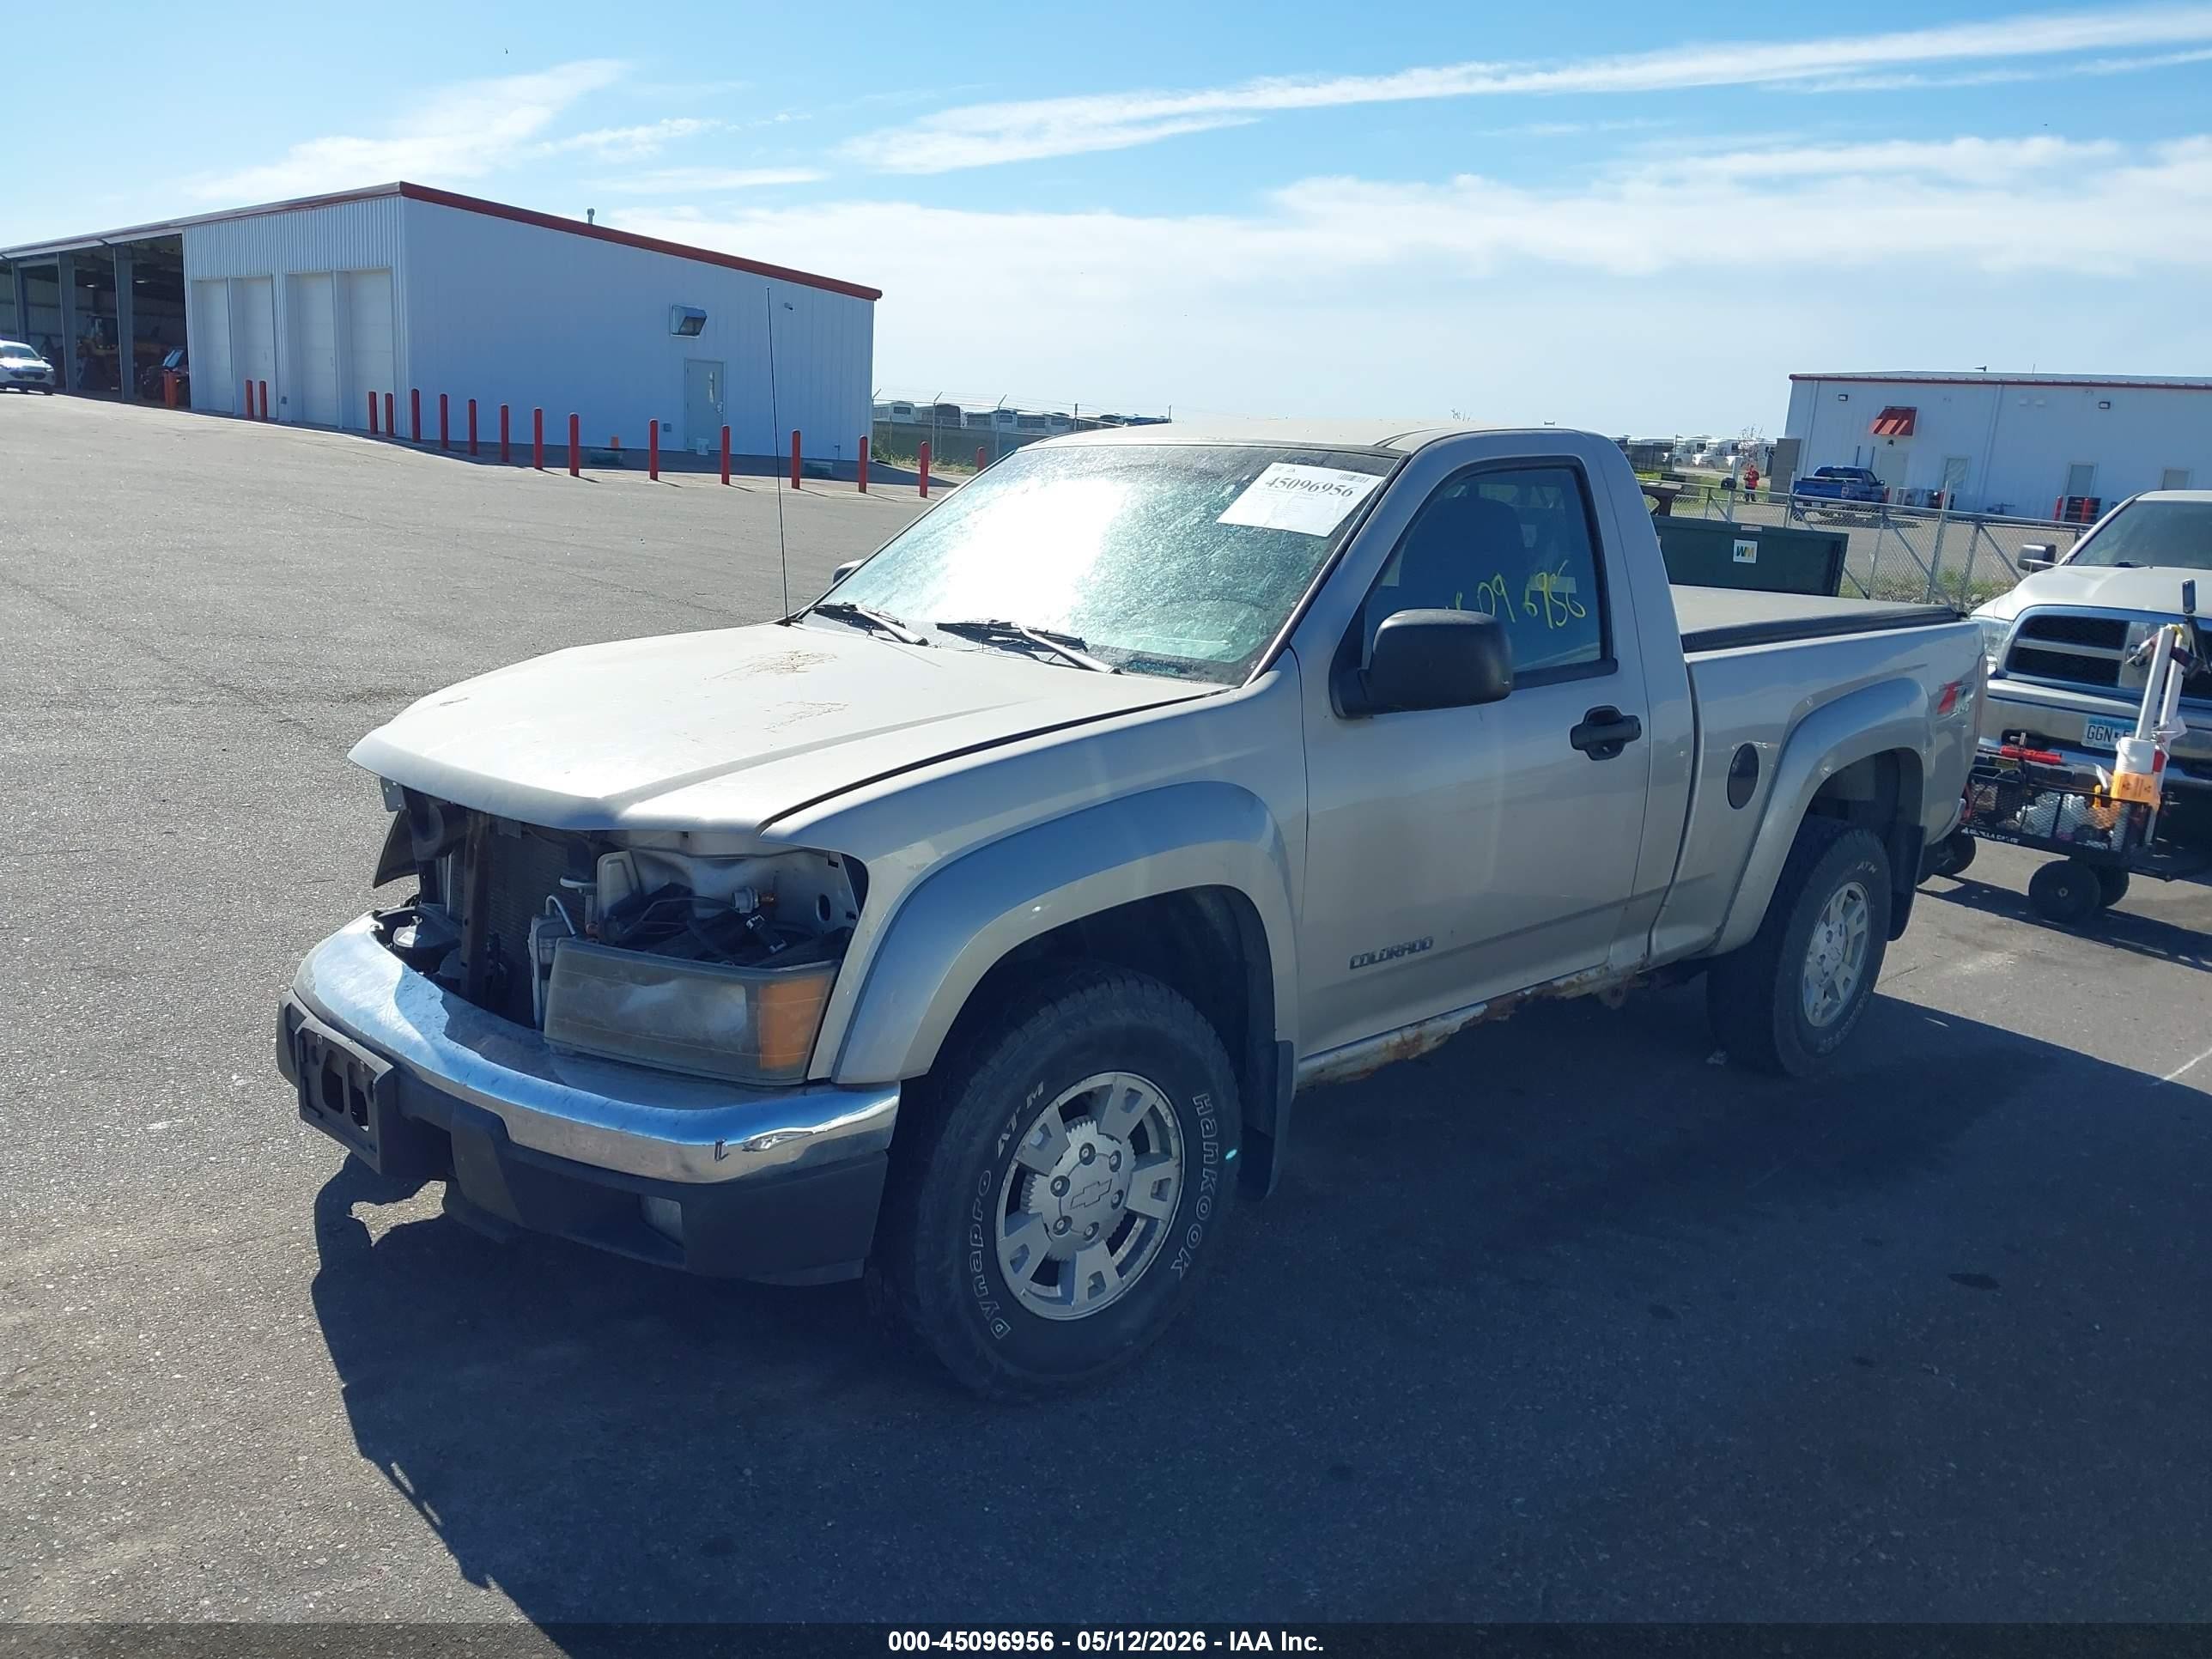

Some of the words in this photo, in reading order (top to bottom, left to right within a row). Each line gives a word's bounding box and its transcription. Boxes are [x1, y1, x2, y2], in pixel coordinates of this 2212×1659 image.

[1266, 477, 1358, 498] 45096956
[1736, 545, 1755, 557] WM
[2087, 725, 2112, 743] GGN
[1349, 936, 1434, 969] COLORADO
